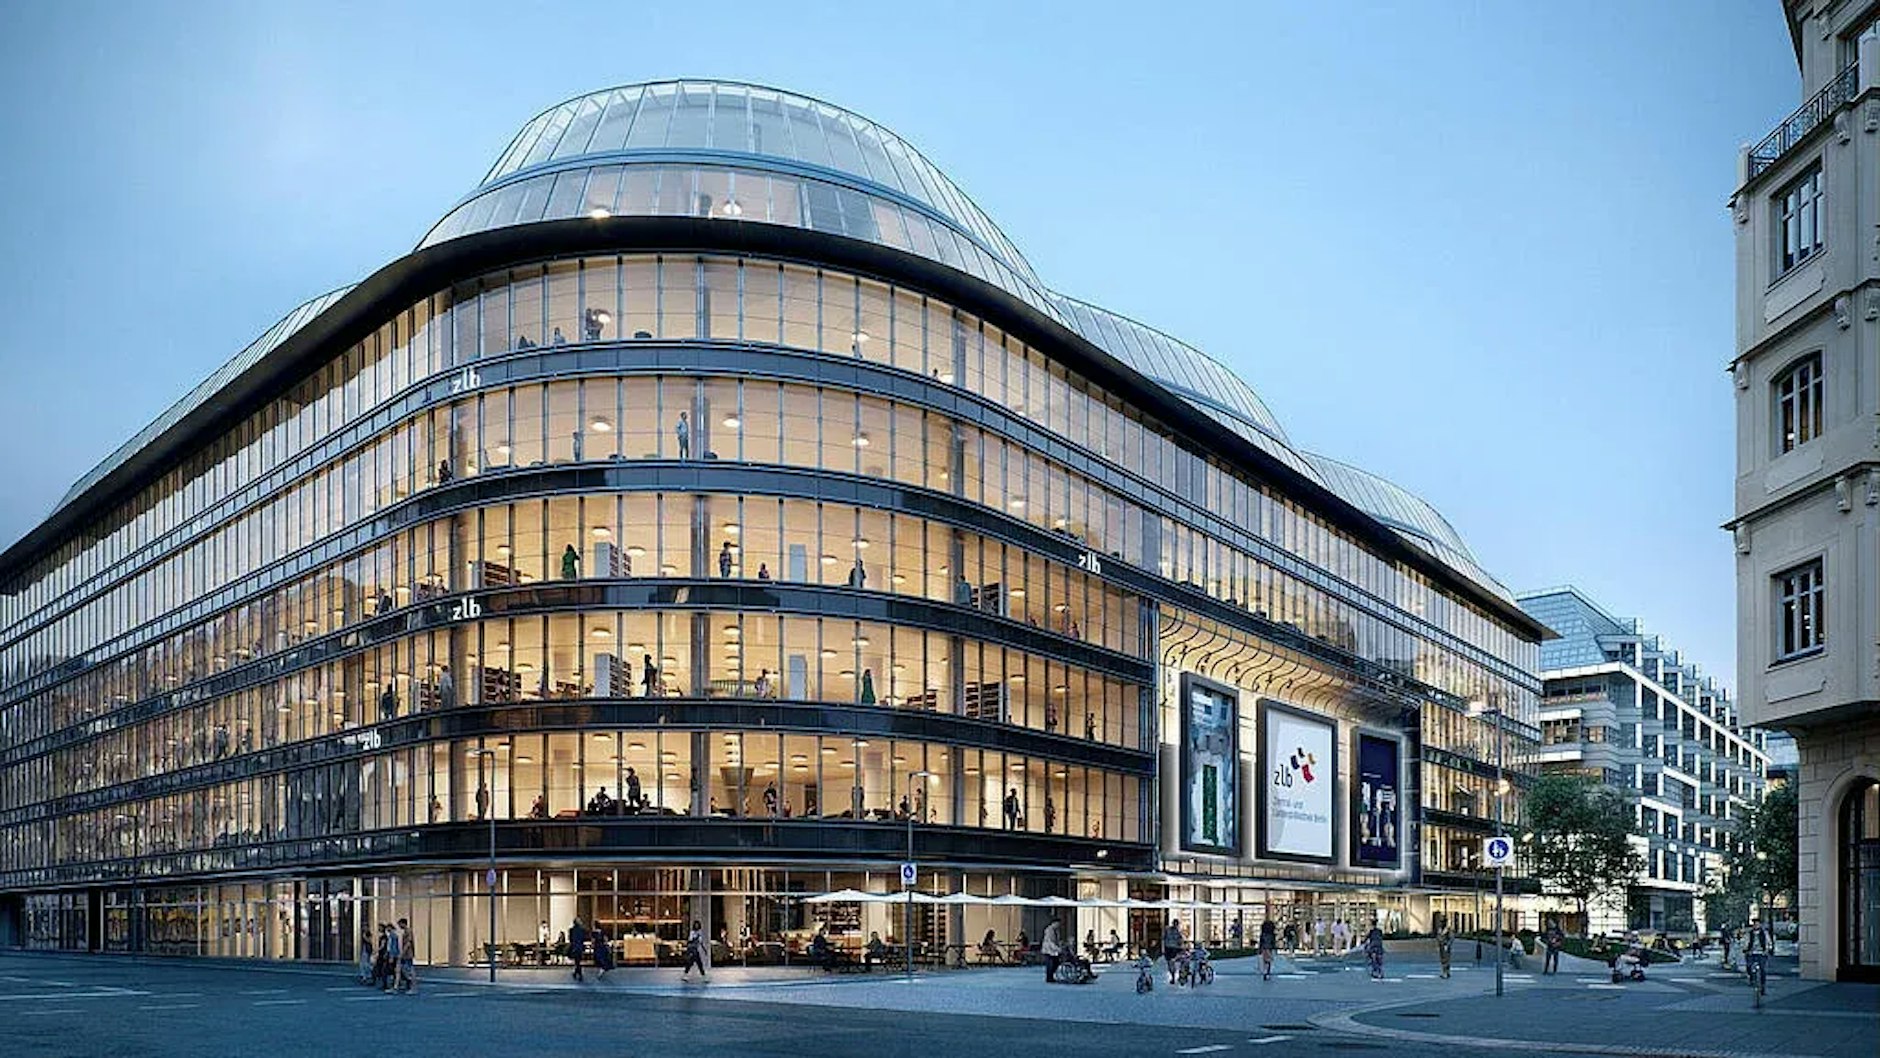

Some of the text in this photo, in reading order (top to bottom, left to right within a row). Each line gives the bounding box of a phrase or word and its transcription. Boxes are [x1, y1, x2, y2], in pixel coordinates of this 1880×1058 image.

[453, 368, 480, 393] zlb
[1079, 551, 1101, 574] zlb
[453, 596, 481, 620] zlb
[363, 728, 381, 750] zlb
[1274, 764, 1293, 788] zlb
